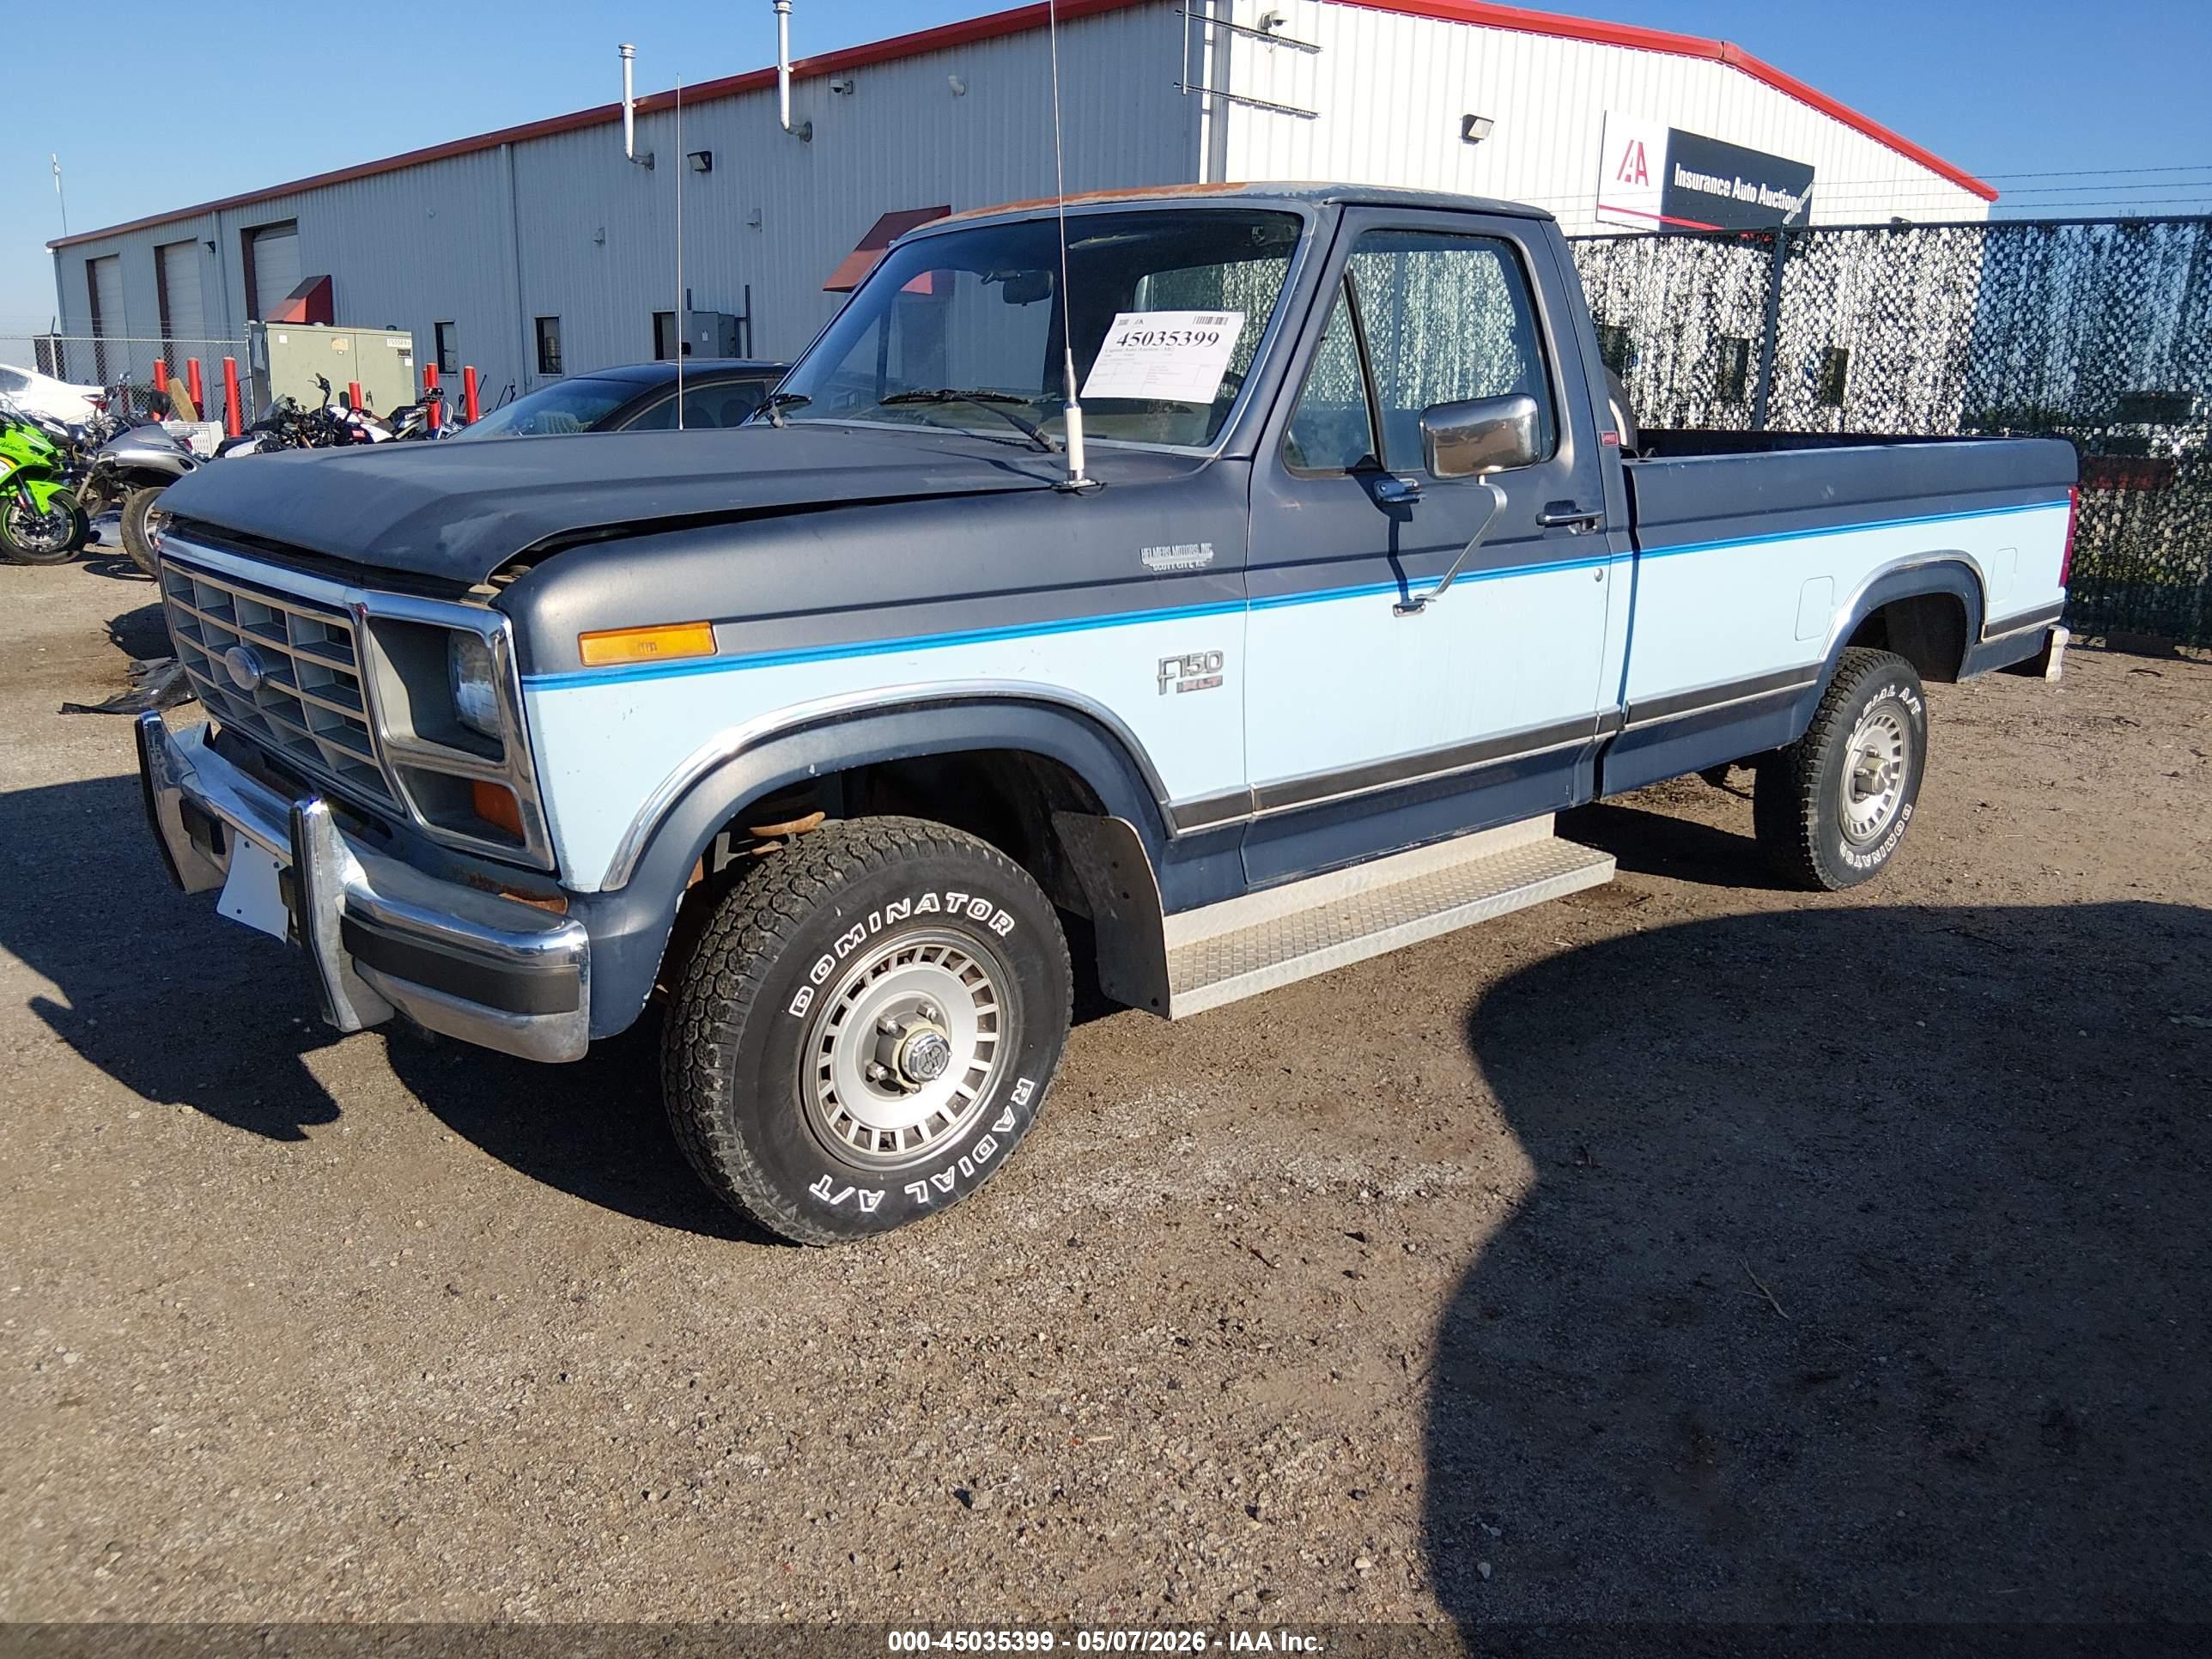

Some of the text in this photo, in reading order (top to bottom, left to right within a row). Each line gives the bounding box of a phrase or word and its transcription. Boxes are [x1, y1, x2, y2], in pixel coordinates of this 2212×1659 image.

[1674, 162, 1802, 214] Insurance Auto Auction
[1115, 330, 1220, 348] 45035399
[1899, 686, 1922, 715] A/T
[1839, 803, 1913, 869] DOMINATOR
[788, 891, 1016, 1018] DOMINATOR
[809, 1078, 1038, 1212] RADIAL A/T
